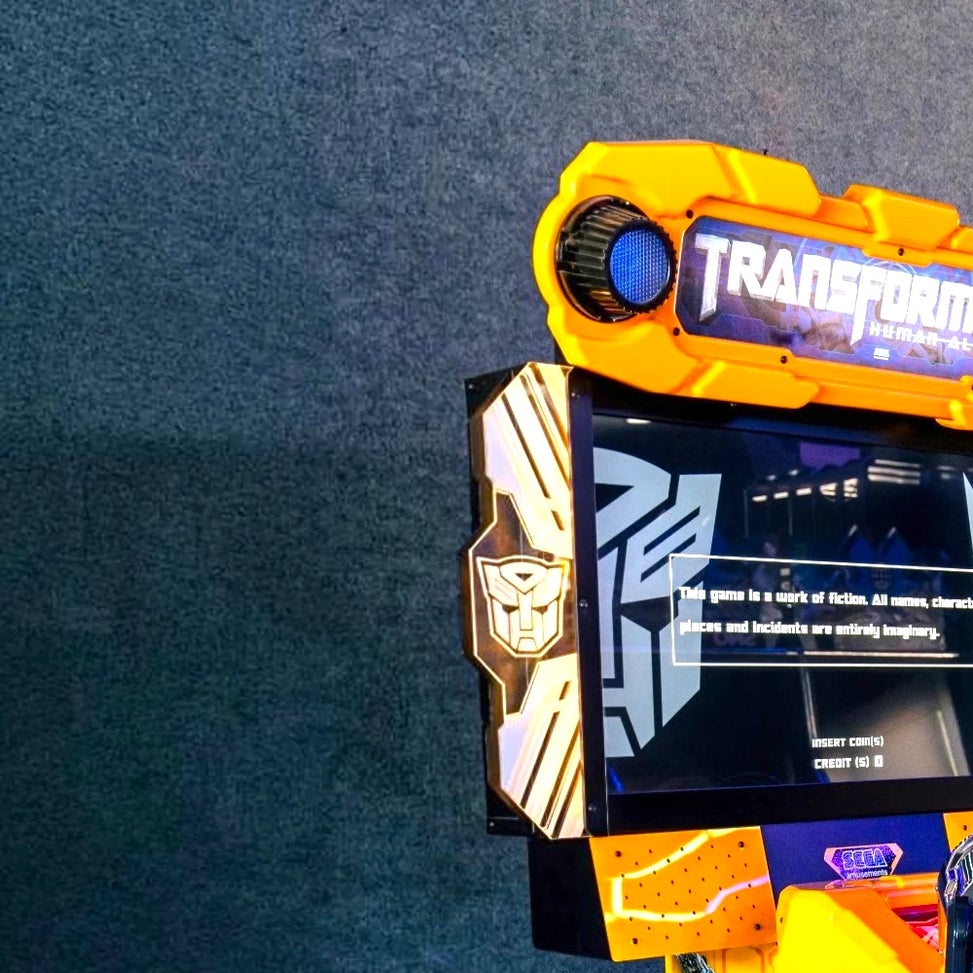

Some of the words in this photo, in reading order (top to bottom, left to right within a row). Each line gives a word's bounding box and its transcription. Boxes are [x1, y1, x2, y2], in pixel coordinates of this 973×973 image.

[870, 322, 939, 347] HUMAN
[678, 586, 706, 600] This
[710, 589, 745, 604] game
[776, 591, 808, 604] work
[812, 592, 825, 604] of
[829, 592, 869, 605] fiction.
[872, 594, 888, 606] All
[679, 619, 722, 636] places
[726, 620, 749, 633] and
[812, 624, 833, 635] are
[835, 623, 880, 639] entirely
[811, 738, 847, 748] INSERT
[849, 735, 885, 748] COIN(S)
[814, 757, 852, 769] CREDIT
[842, 847, 889, 870] SEGA
[846, 868, 889, 880] amusements
